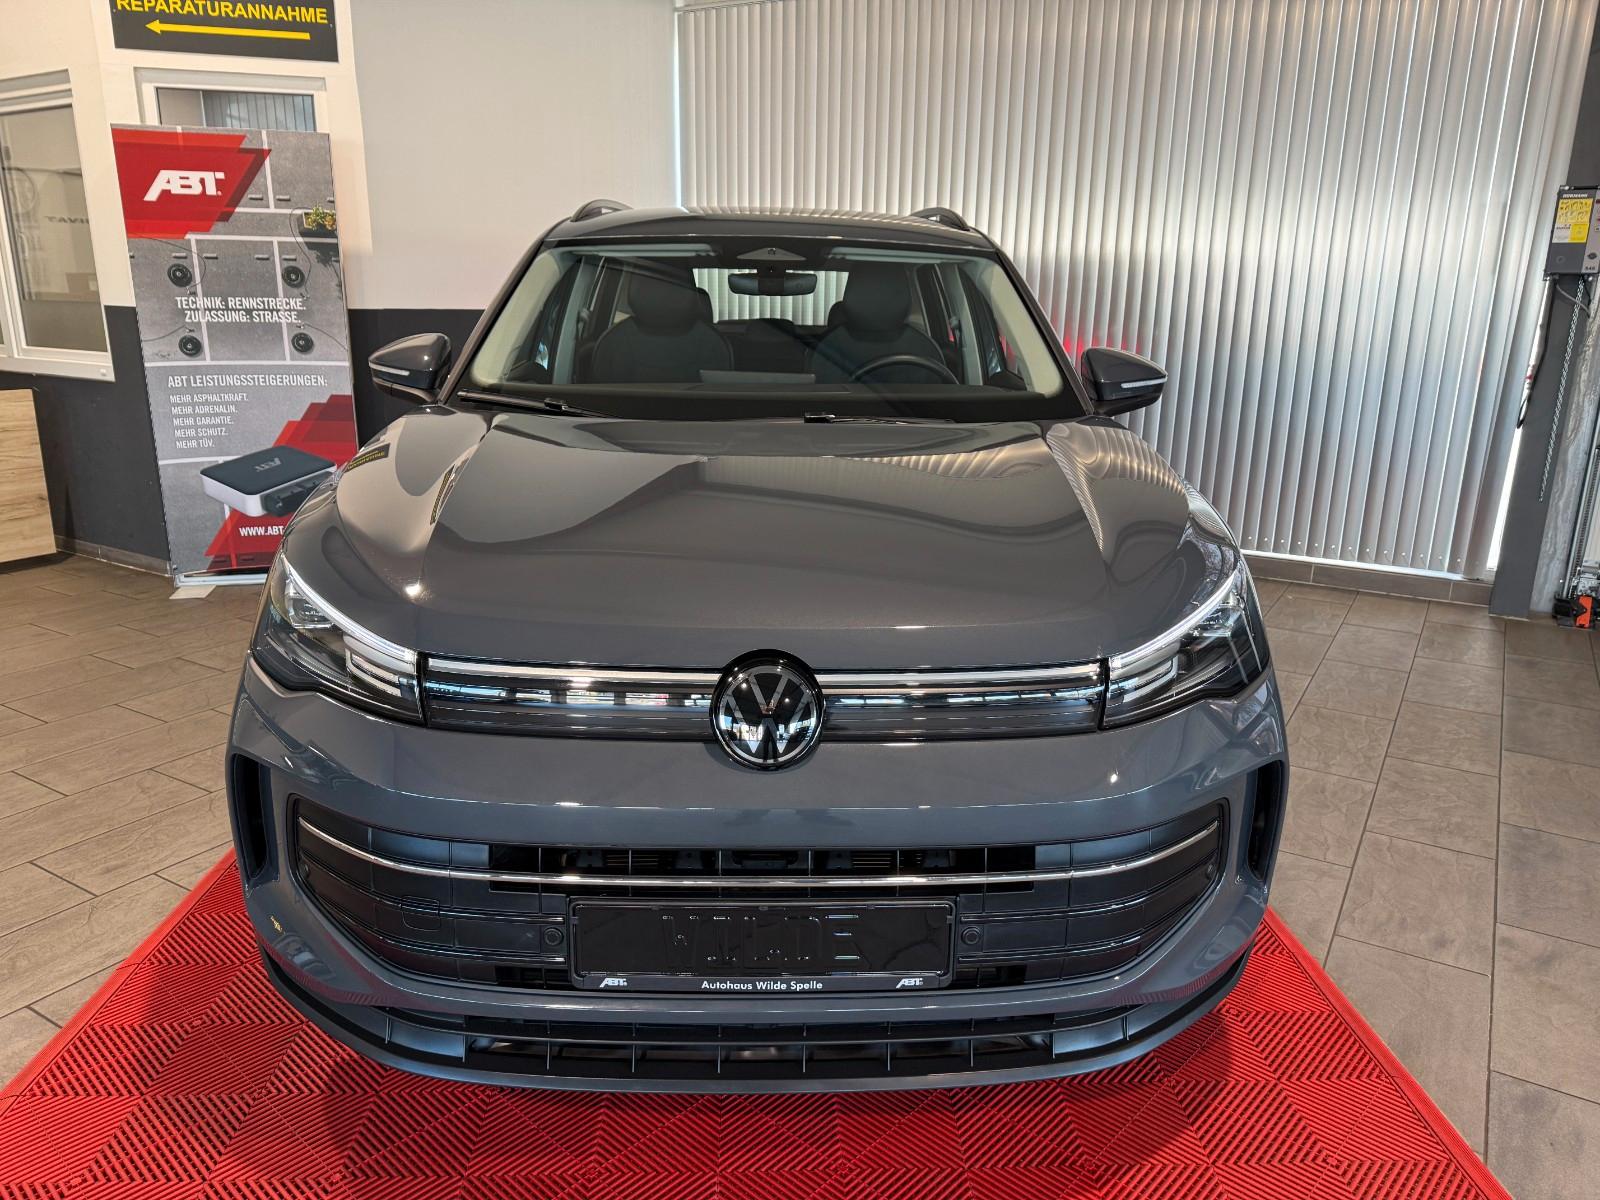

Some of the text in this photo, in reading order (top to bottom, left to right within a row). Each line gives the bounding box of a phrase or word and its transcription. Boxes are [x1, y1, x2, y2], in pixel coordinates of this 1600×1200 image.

[116, 0, 329, 24] REPARATURANNAHME
[175, 296, 307, 310] TECHNIK: RENNSTRECKE.
[184, 310, 302, 323] ZULASSUNG: STRASSE.
[168, 374, 328, 388] ABT LEISTUNGSSTEIGERUNGEN:
[170, 393, 249, 403] MEHR ASPHALTKRAFT.
[172, 405, 238, 415] MEHR ADRENALIN.
[173, 416, 234, 426] MEHR GARANTIE.
[175, 427, 229, 438] MEHR SCHUTZ.
[176, 438, 215, 449] MEHR TÜV.
[238, 525, 285, 537] WWW.ABT
[701, 979, 823, 993] Autohaus Wilde Spelle
